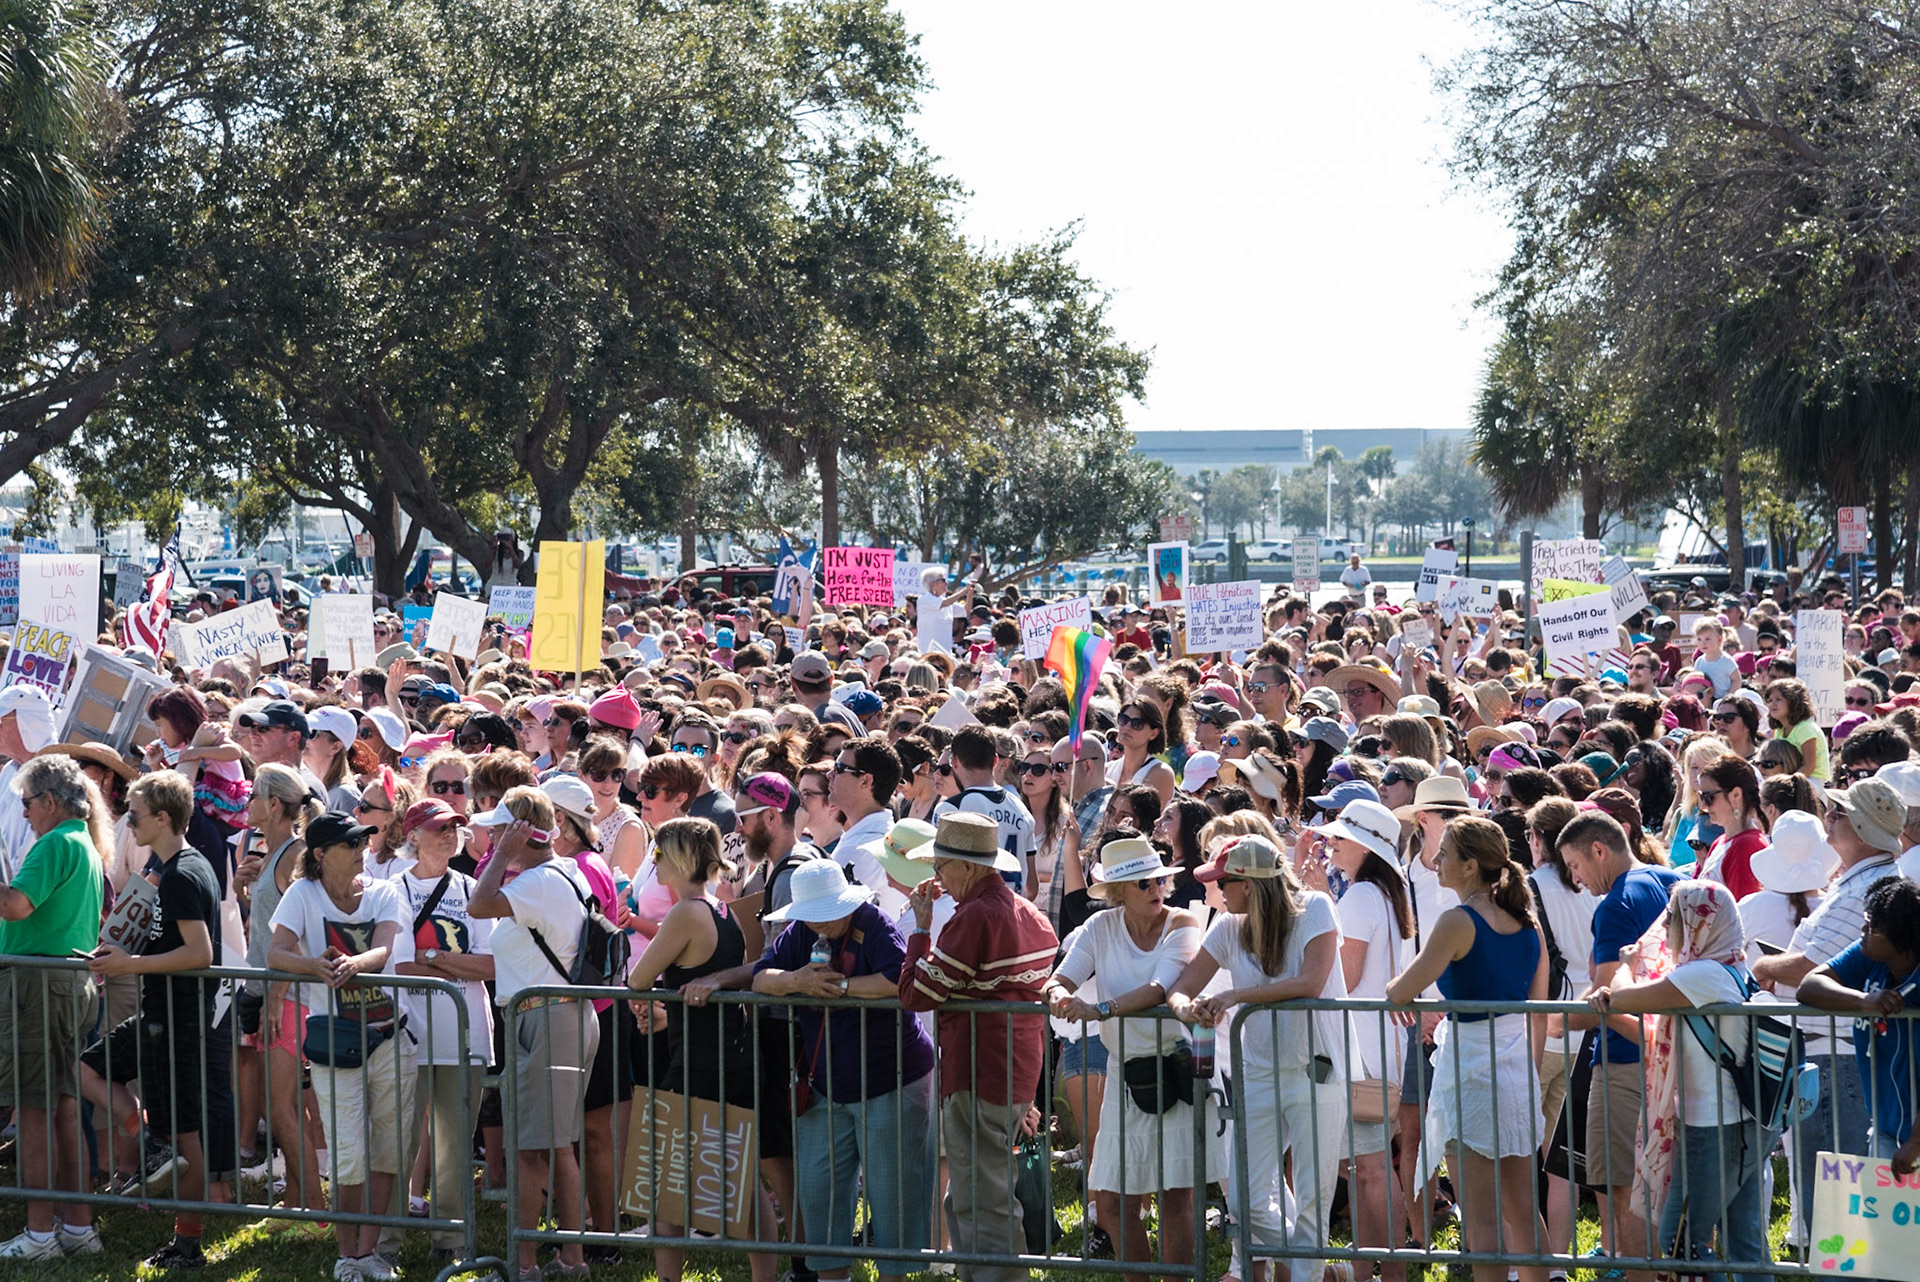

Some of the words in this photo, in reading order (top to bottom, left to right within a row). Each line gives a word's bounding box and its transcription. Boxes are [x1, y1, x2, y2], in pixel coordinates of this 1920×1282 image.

[1840, 509, 1853, 522] NO
[27, 537, 34, 545] IT
[40, 541, 56, 551] WAS
[828, 549, 848, 568] I'M
[855, 551, 891, 569] JUST
[1532, 542, 1556, 566] They
[1558, 542, 1585, 557] tried
[1587, 542, 1598, 555] to
[41, 560, 84, 578] LIVING
[827, 570, 858, 585] Here
[1574, 559, 1598, 578] They
[1, 580, 19, 588] FOR
[51, 584, 76, 599] LA
[1186, 585, 1211, 600] TRUE
[1611, 574, 1643, 611] WILL!
[515, 590, 533, 599] YOUR
[829, 587, 860, 603] FREE
[494, 600, 509, 608] TINY
[1191, 599, 1218, 614] HATES
[1222, 597, 1260, 615] Injustice
[44, 605, 77, 623] VIDA
[1022, 601, 1086, 629] MAKING
[1204, 612, 1216, 625] its
[1236, 610, 1256, 623] land
[1590, 608, 1607, 619] Our
[1801, 613, 1807, 630] I
[1808, 613, 1838, 631] MARCH
[15, 620, 72, 661] PEACE
[197, 617, 244, 648] NASTY
[1551, 632, 1574, 643] Civil
[1578, 627, 1609, 639] Rights
[194, 643, 243, 668] WOMEN
[247, 630, 281, 649] UNITE
[8, 649, 65, 685] LOVE
[989, 808, 1025, 830] ODRIĆ
[625, 1092, 671, 1215] EQUALITY
[1822, 1156, 1865, 1184] MY
[1849, 1194, 1879, 1219] IS
